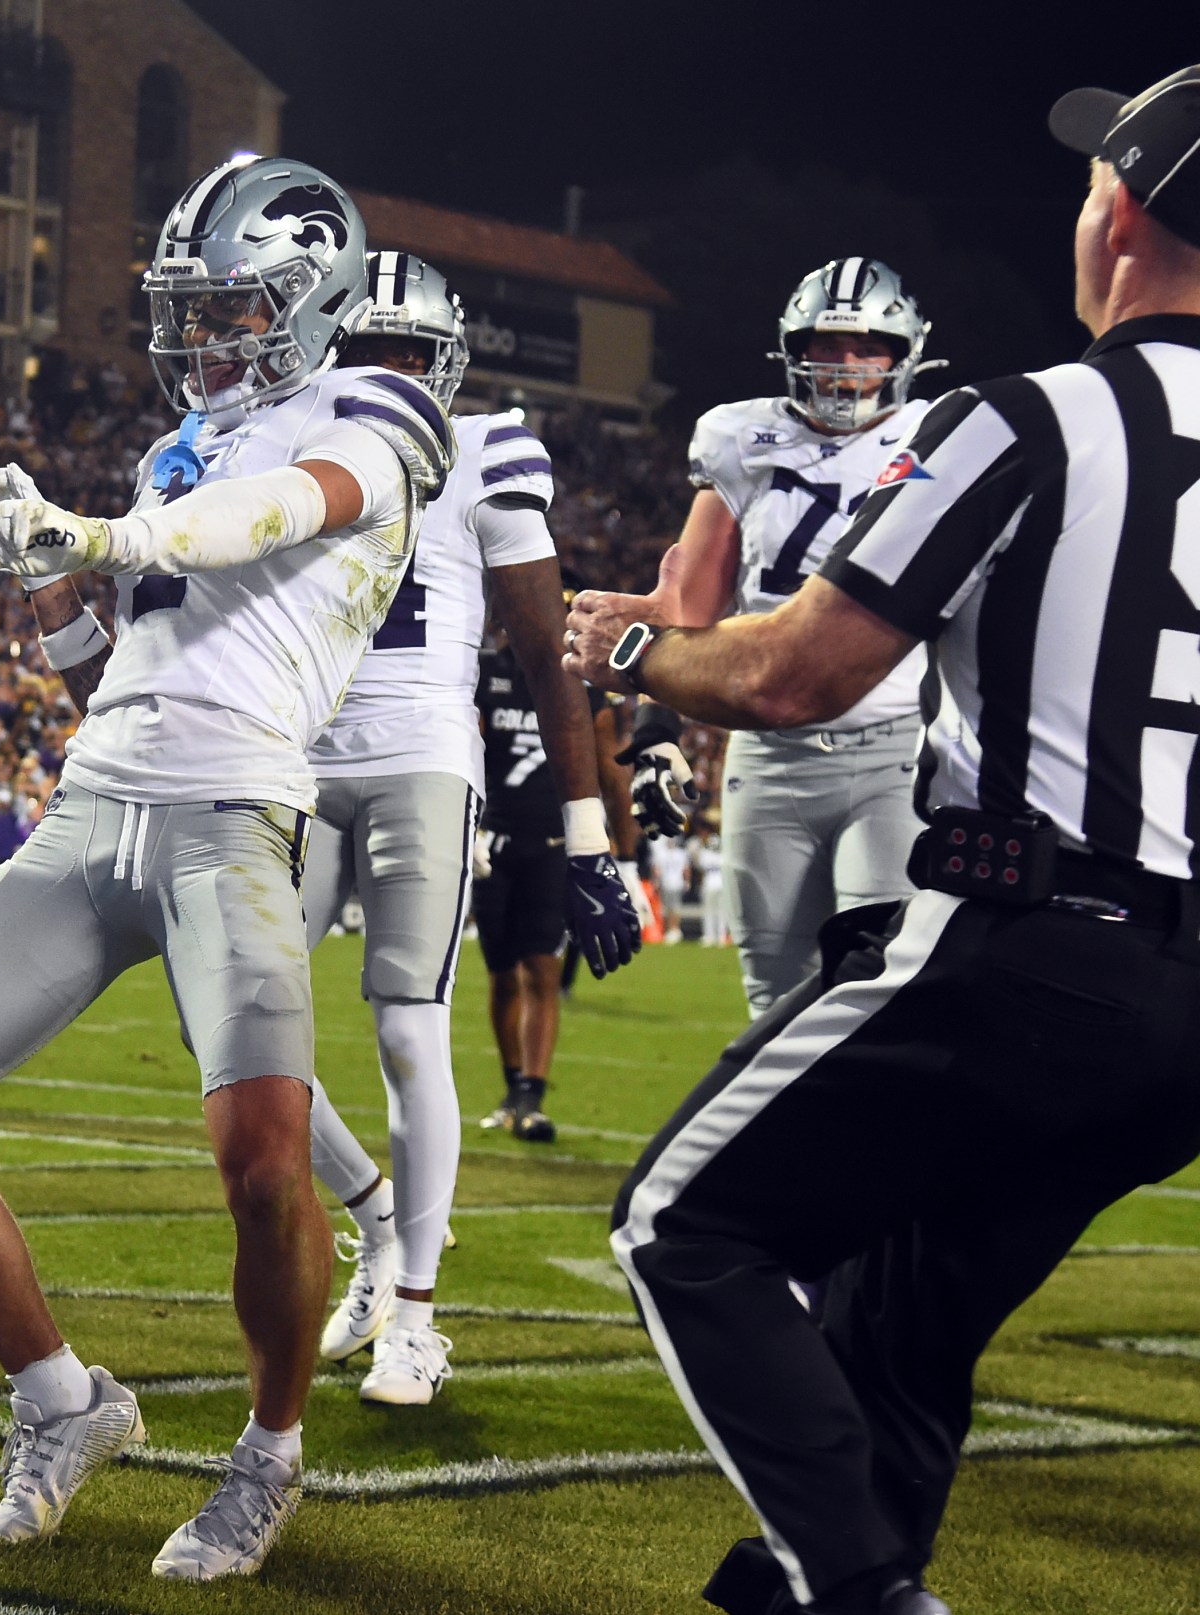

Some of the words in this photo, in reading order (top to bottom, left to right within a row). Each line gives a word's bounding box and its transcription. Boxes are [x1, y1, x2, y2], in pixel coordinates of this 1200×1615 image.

[160, 265, 195, 275] K-STATE
[752, 432, 780, 445] XII
[26, 527, 77, 551] ats
[759, 466, 872, 596] 7
